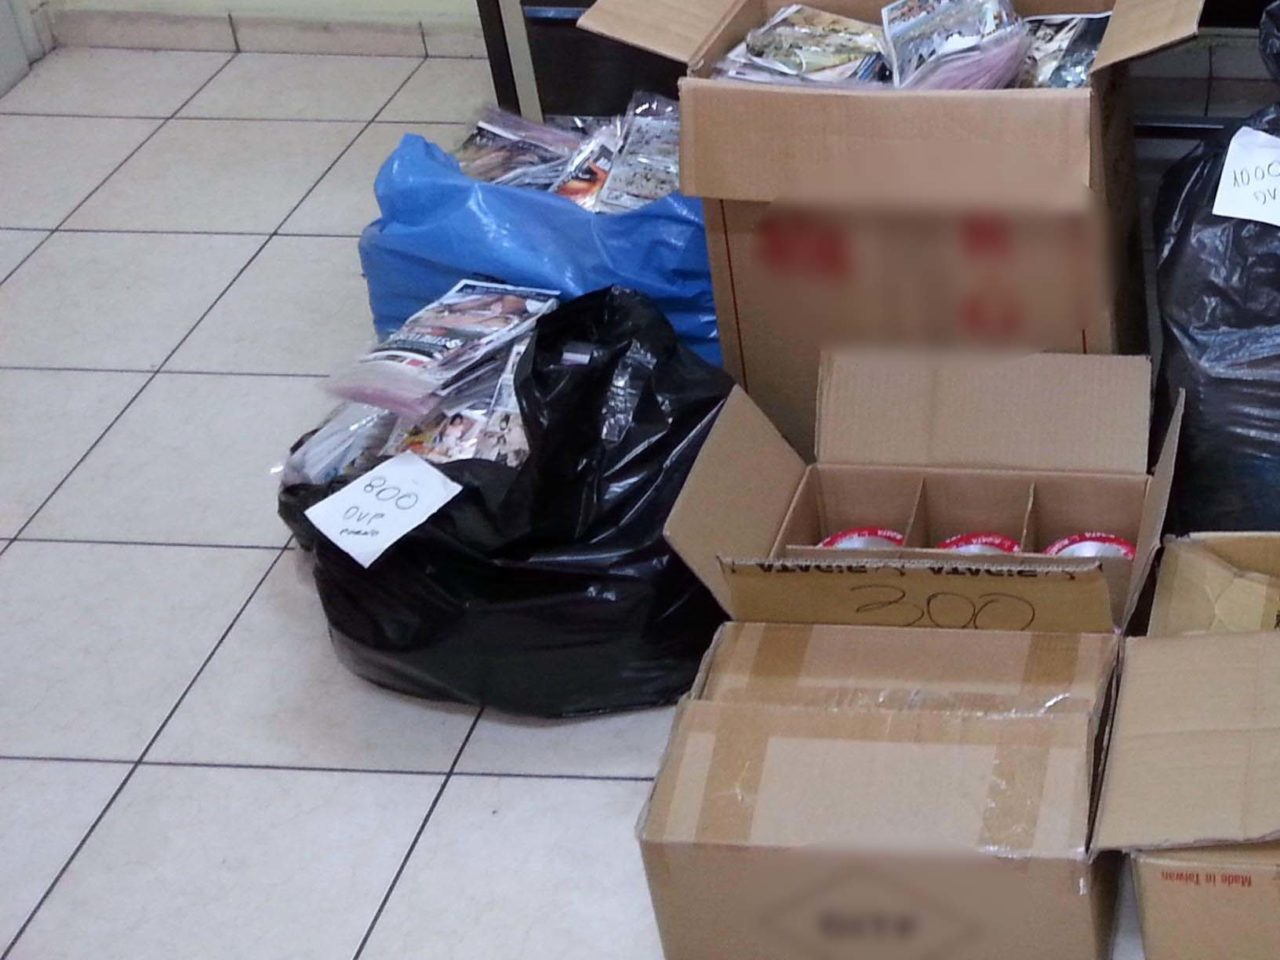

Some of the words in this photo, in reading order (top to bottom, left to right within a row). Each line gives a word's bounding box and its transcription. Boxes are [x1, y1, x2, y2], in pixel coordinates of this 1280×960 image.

[363, 476, 419, 511] 800
[1161, 870, 1200, 886] Taiwan
[1205, 873, 1217, 885] in
[1220, 874, 1252, 888] Made
